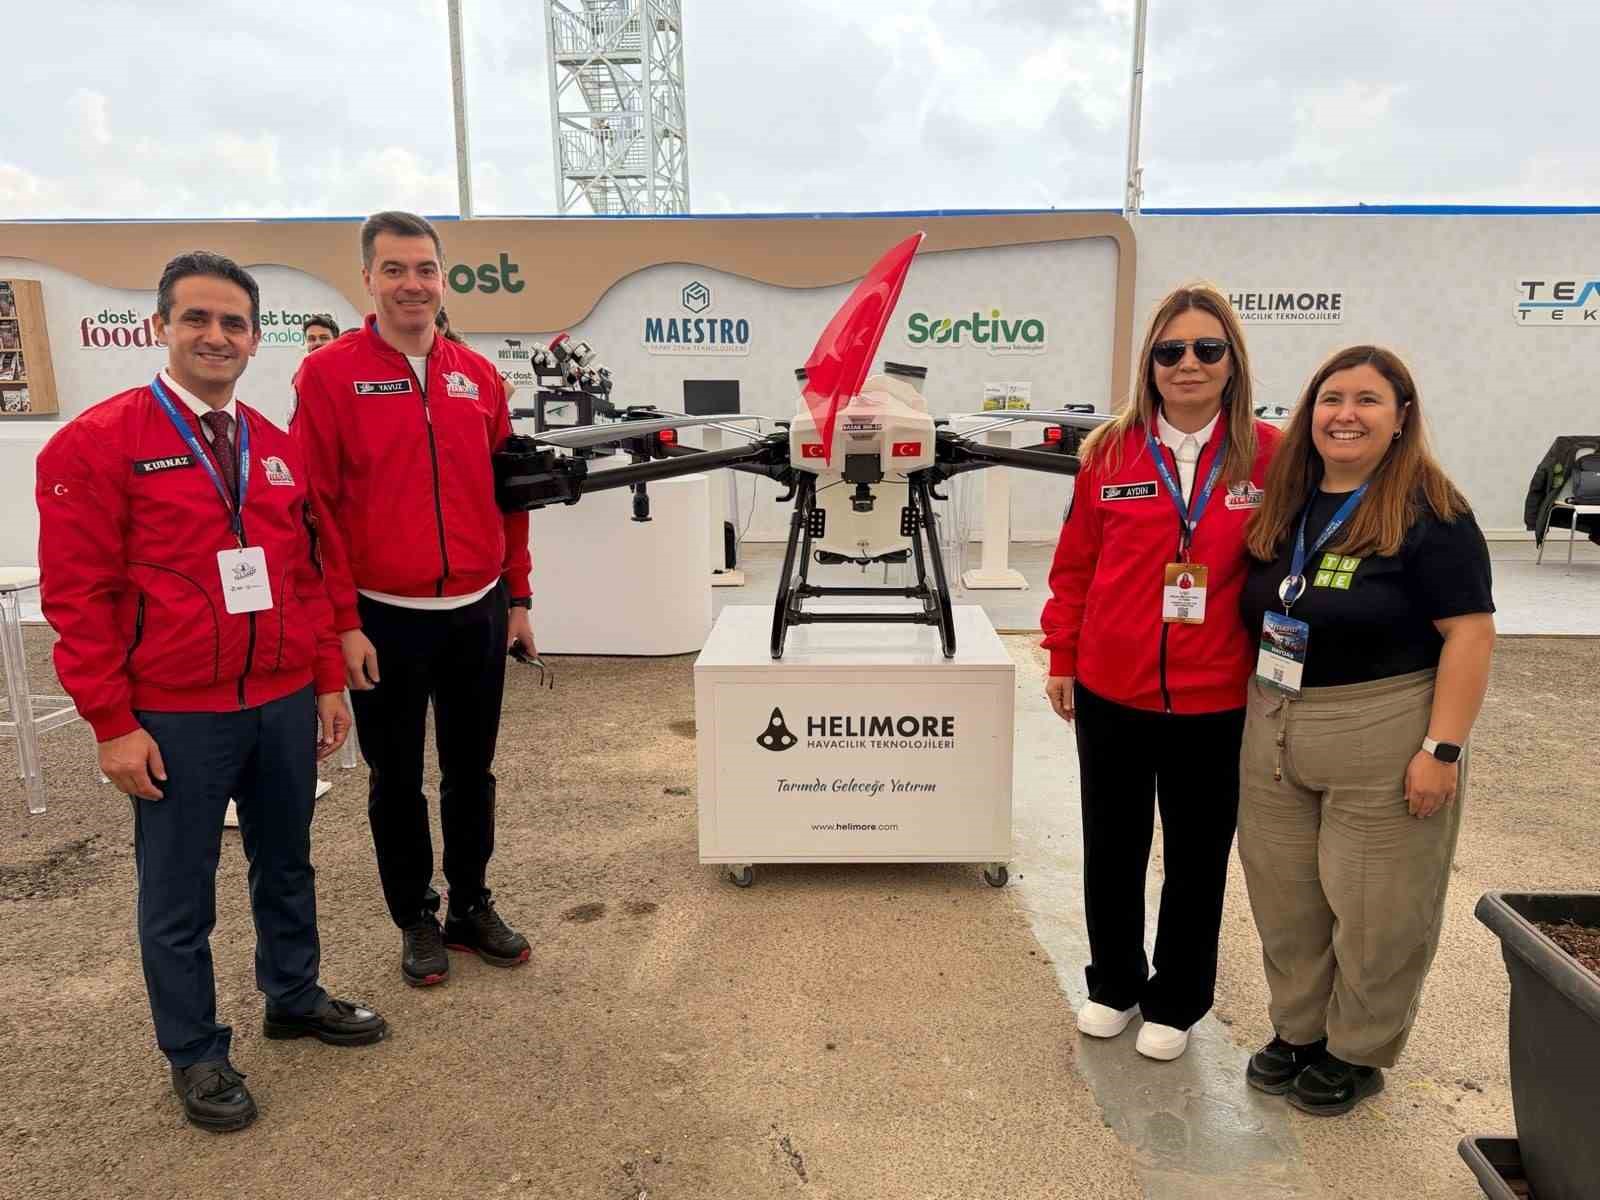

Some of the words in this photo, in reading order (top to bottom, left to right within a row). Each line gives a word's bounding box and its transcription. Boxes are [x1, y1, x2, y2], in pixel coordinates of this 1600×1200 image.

[448, 252, 525, 294] ost
[1229, 293, 1342, 310] HELIMORE
[97, 309, 137, 324] dost
[260, 311, 279, 326] st
[1240, 312, 1273, 320] VACILIK
[1518, 309, 1597, 321] TEK
[645, 317, 749, 344] MAESTRO
[908, 309, 1045, 343] Sortiva
[807, 716, 955, 738] HELIMORE
[807, 739, 867, 749] HAVACILIK
[871, 739, 955, 750] TEKNOLOJİLERİ
[776, 777, 828, 793] Tarımda
[831, 777, 885, 797] Geleceğe
[890, 778, 937, 793] Yatırım
[811, 823, 899, 832] www.helimore.com
